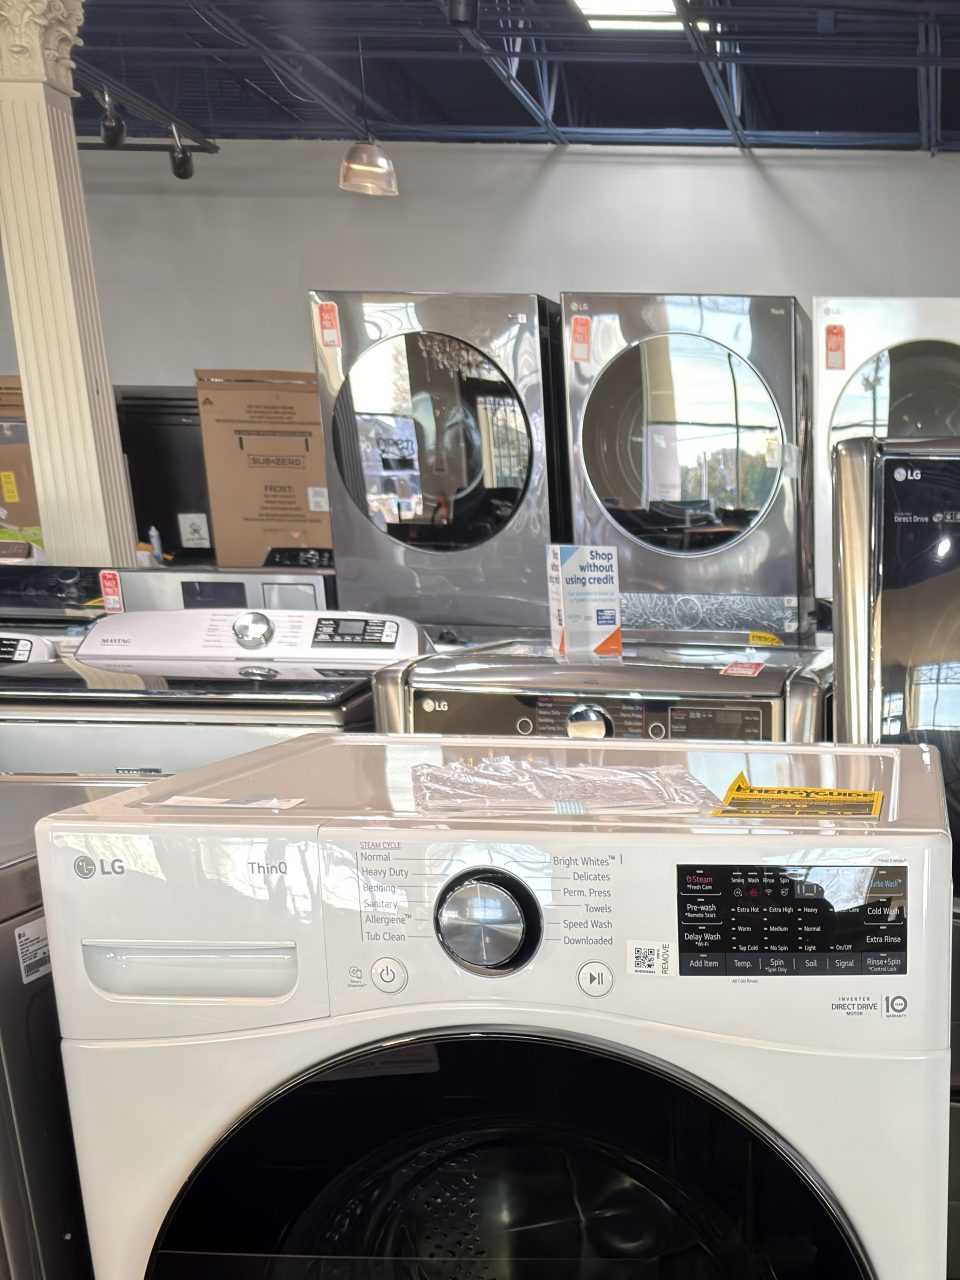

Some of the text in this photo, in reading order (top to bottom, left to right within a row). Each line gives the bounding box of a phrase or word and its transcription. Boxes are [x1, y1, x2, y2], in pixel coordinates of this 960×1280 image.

[907, 470, 921, 480] LG
[590, 550, 613, 562] Shop
[579, 563, 613, 573] without
[566, 576, 614, 587] using credit
[435, 702, 448, 711] LG
[361, 852, 391, 862] Normal
[553, 856, 579, 868] Bright
[100, 859, 125, 875] LG
[248, 861, 288, 876] ThinQ
[362, 868, 409, 878] Heavy Duty
[573, 872, 611, 881] Delicates
[363, 884, 396, 893] Bedding
[563, 888, 611, 897] Perm. Press
[364, 900, 398, 909] Sanitary
[585, 904, 612, 913] Towels
[867, 907, 900, 915] Cold Wash
[563, 920, 613, 930] Speed Wash
[366, 932, 406, 941] Tub Clean
[563, 936, 613, 945] Downloaded
[684, 933, 702, 942] Delay
[662, 944, 670, 974] REMOVE
[734, 959, 753, 968] Temp.
[770, 958, 784, 967] Spin
[867, 958, 901, 966] Rinse+Spin
[836, 960, 854, 968] Signal
[885, 995, 908, 1013] 10
